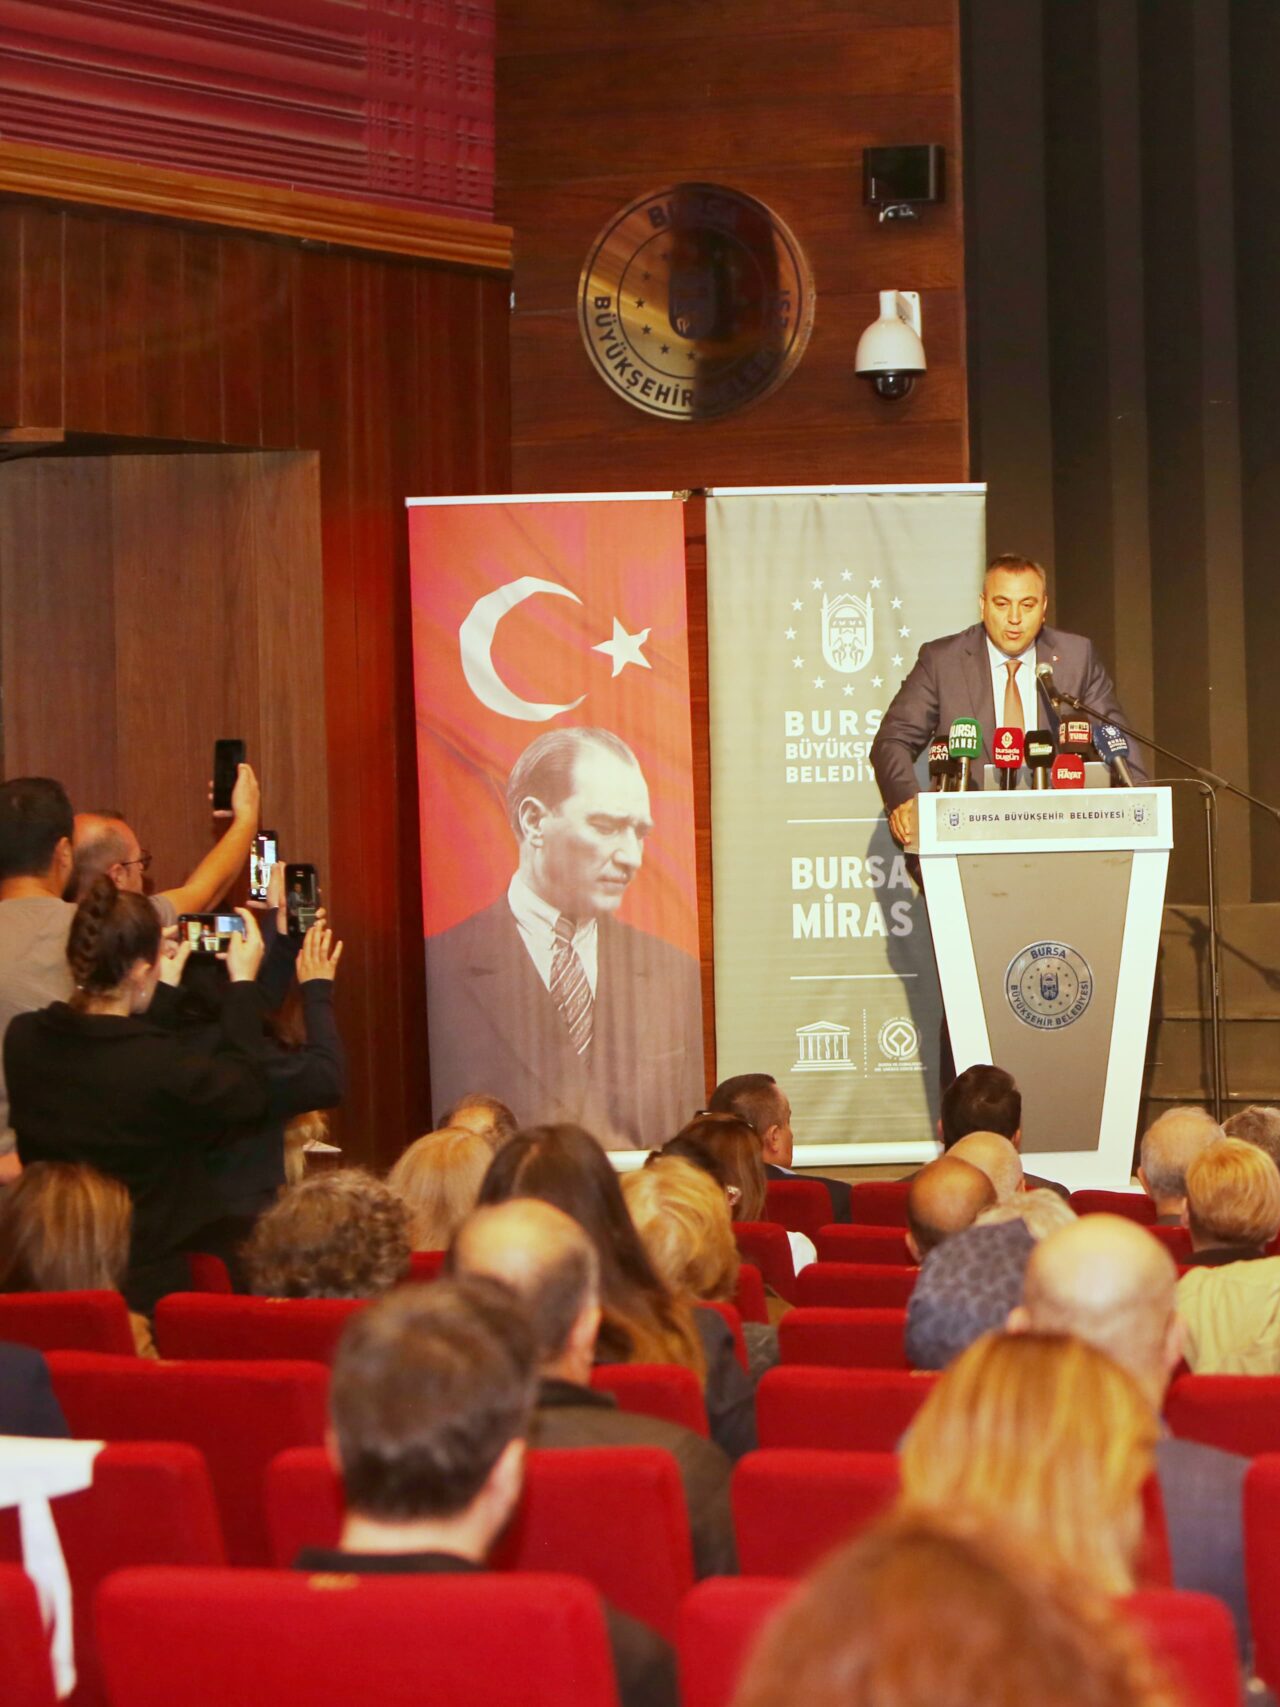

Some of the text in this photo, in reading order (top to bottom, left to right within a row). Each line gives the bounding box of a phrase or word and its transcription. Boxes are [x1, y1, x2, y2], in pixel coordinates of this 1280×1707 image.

[594, 296, 695, 408] BÜYÜKŞEHİR
[969, 809, 1124, 822] BURSA BÜYÜKŞEHİR BELEDİYESİ
[792, 854, 912, 890] BURSA
[792, 893, 913, 939] MİRAS
[1030, 946, 1066, 960] BURSA
[1010, 980, 1089, 1026] BÜYÜKŞEHİR BELEDİYESİ
[799, 1035, 848, 1060] UNESCO
